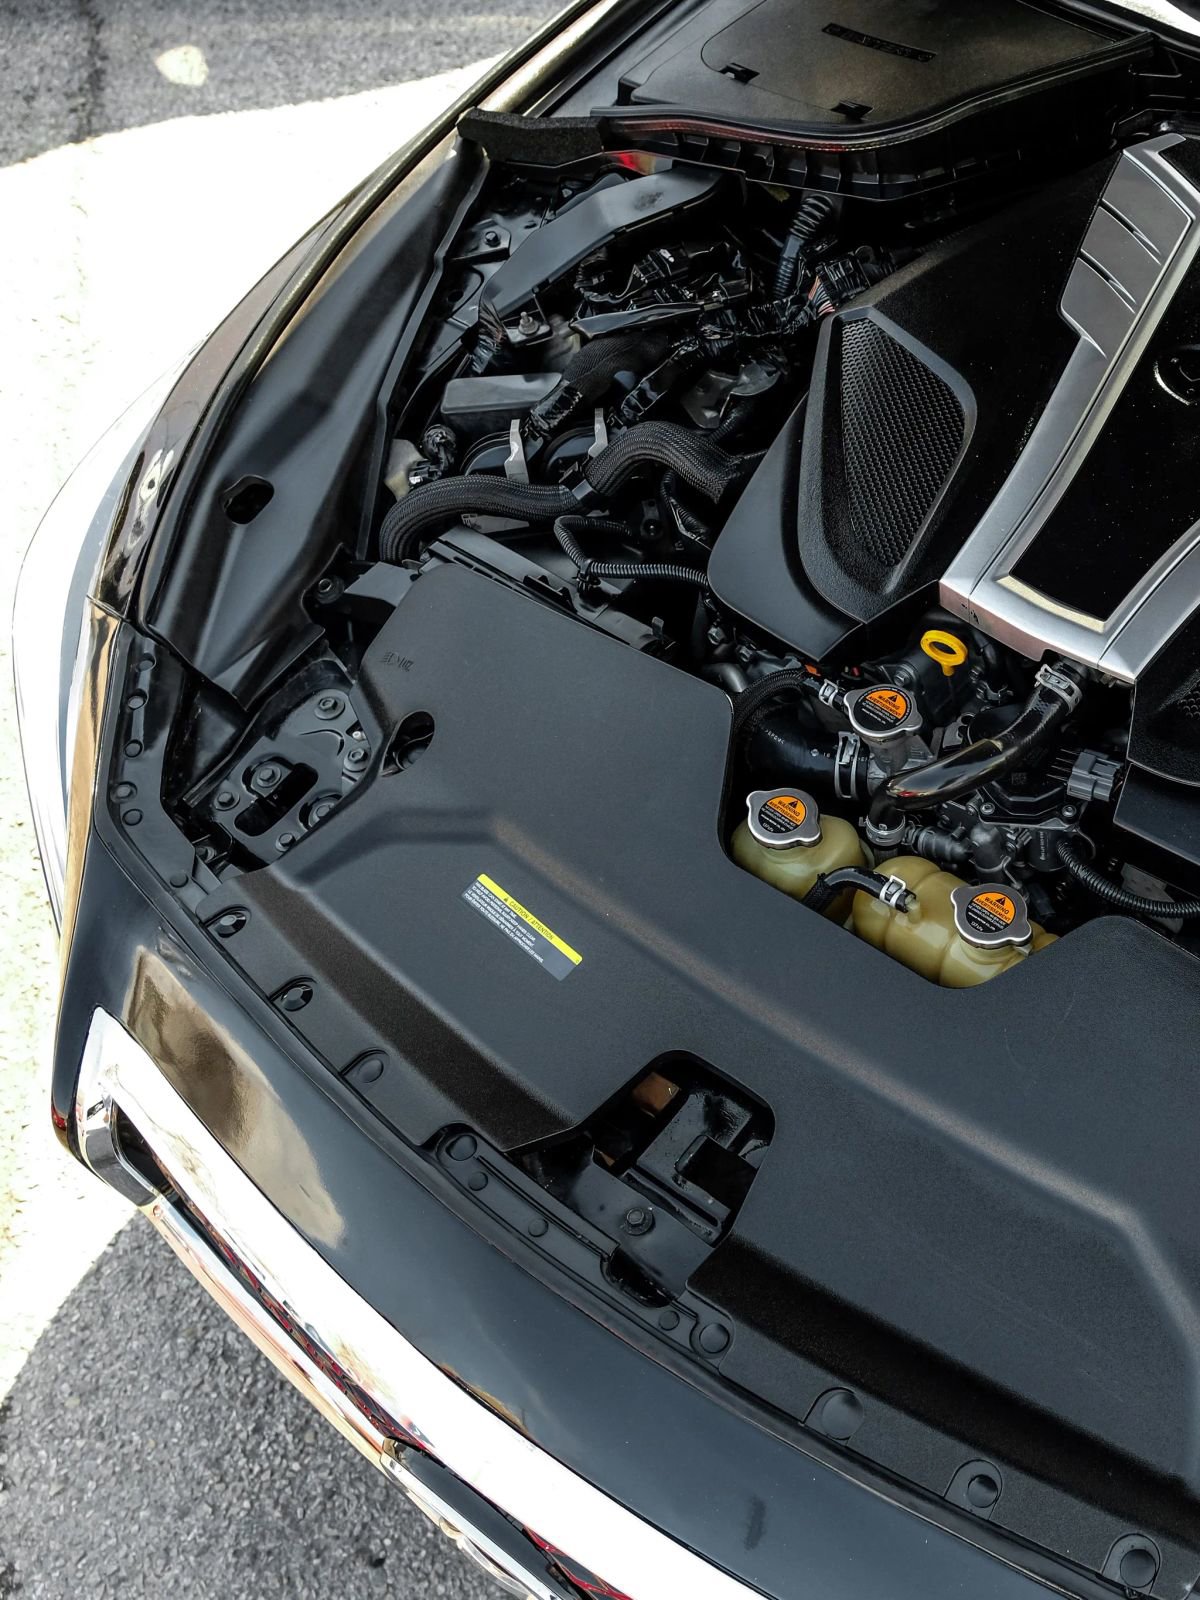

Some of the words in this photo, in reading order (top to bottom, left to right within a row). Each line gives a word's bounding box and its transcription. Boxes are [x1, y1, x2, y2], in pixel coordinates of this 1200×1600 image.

[777, 800, 801, 817] WARNING
[975, 898, 1011, 922] AVERTISSEMENT
[984, 896, 1010, 915] WARNING
[509, 901, 529, 919] CAUTION
[531, 919, 555, 941] ATTENTION
